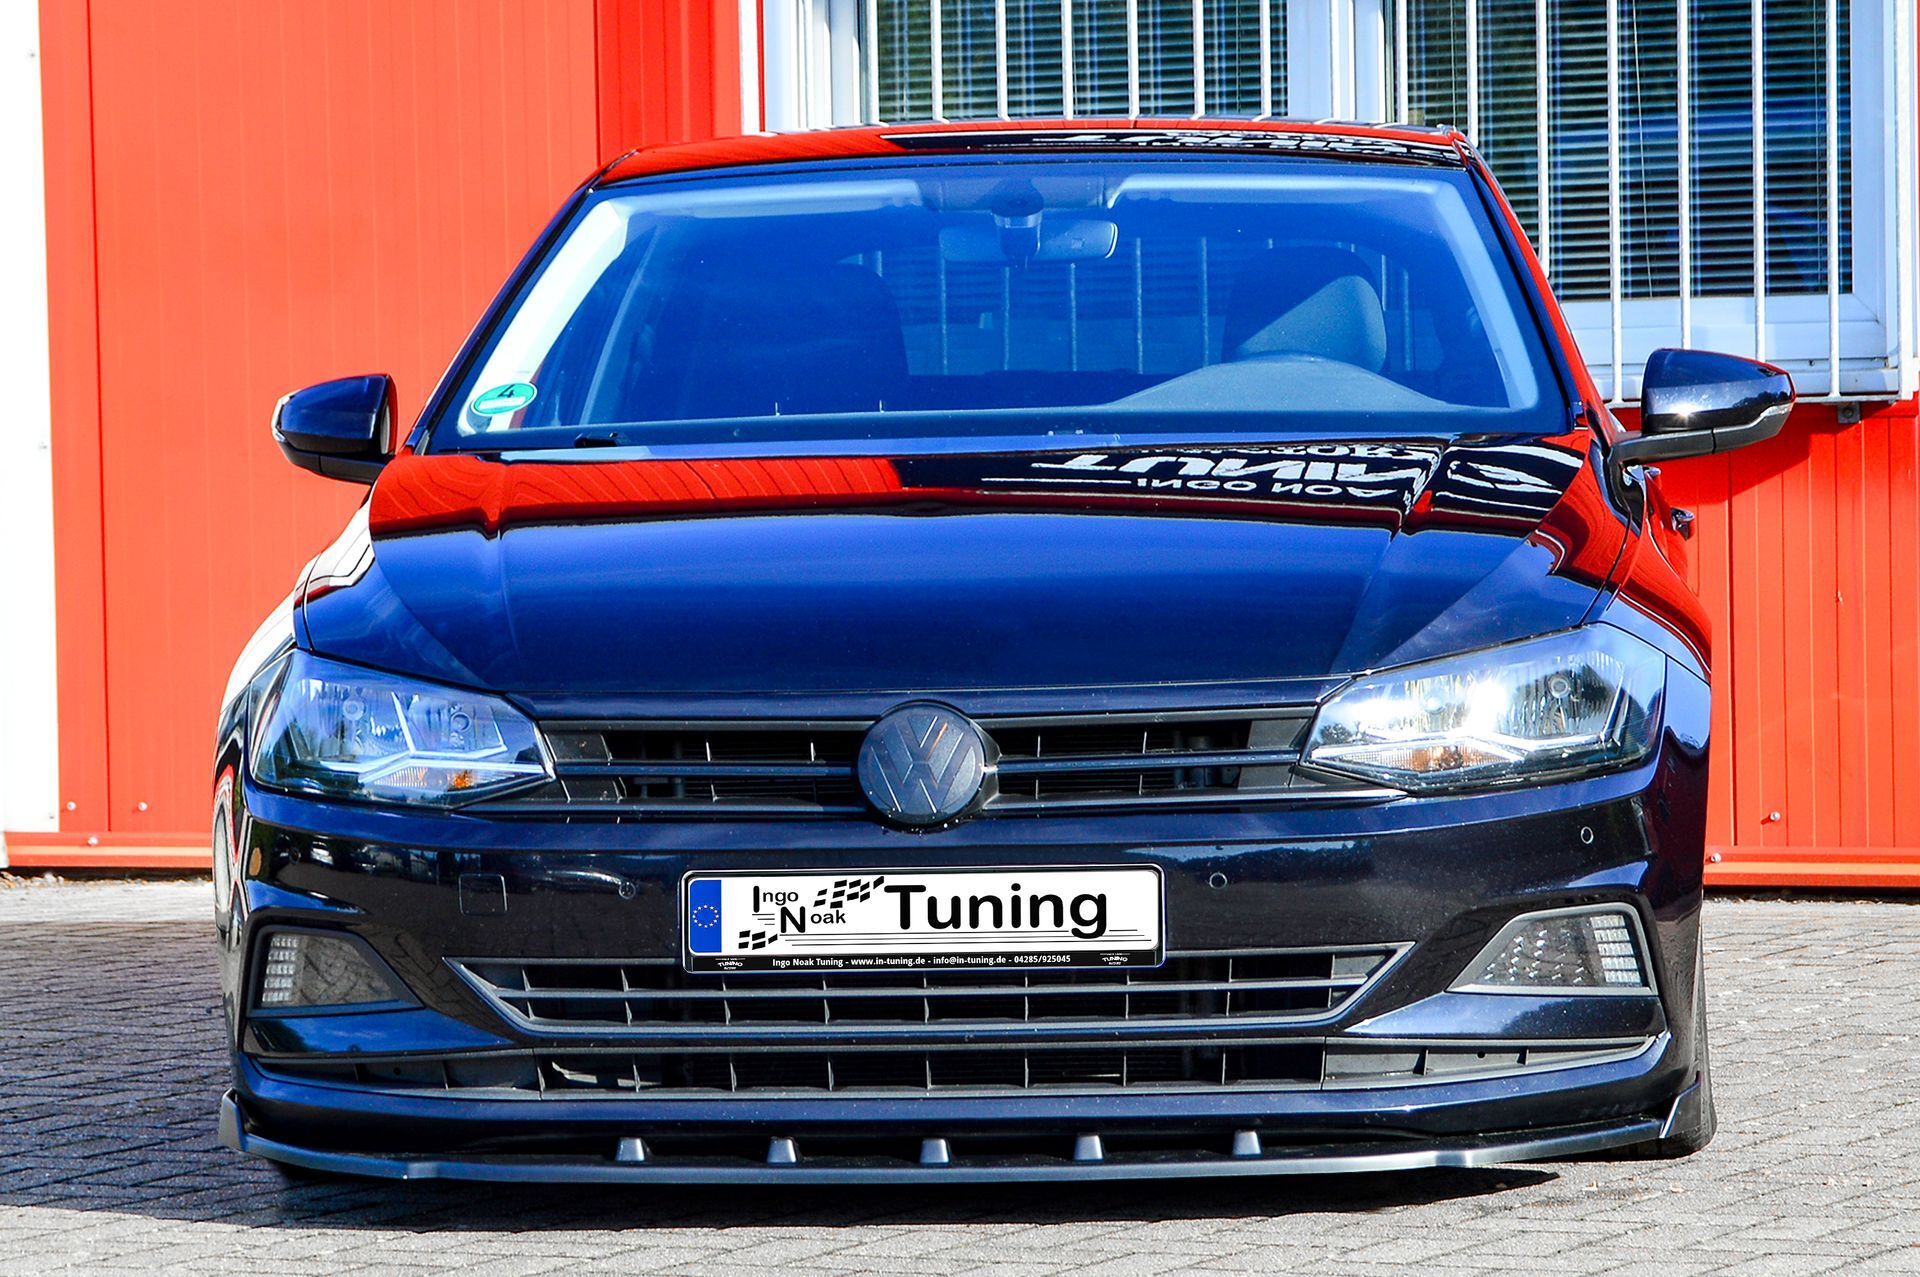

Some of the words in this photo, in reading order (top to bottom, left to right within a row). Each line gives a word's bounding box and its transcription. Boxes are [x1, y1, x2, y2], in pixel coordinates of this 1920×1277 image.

[497, 384, 515, 398] 4
[753, 885, 799, 913] Ingo
[884, 882, 1107, 939] Tuning
[780, 906, 846, 933] Noak
[772, 958, 790, 968] Ingo
[792, 958, 815, 966] Noak
[816, 957, 843, 968] Tuning
[851, 956, 926, 967] www.in-tuning.de
[933, 955, 1007, 966] info@in-tuning.de
[1014, 955, 1071, 963] 04285/925045
